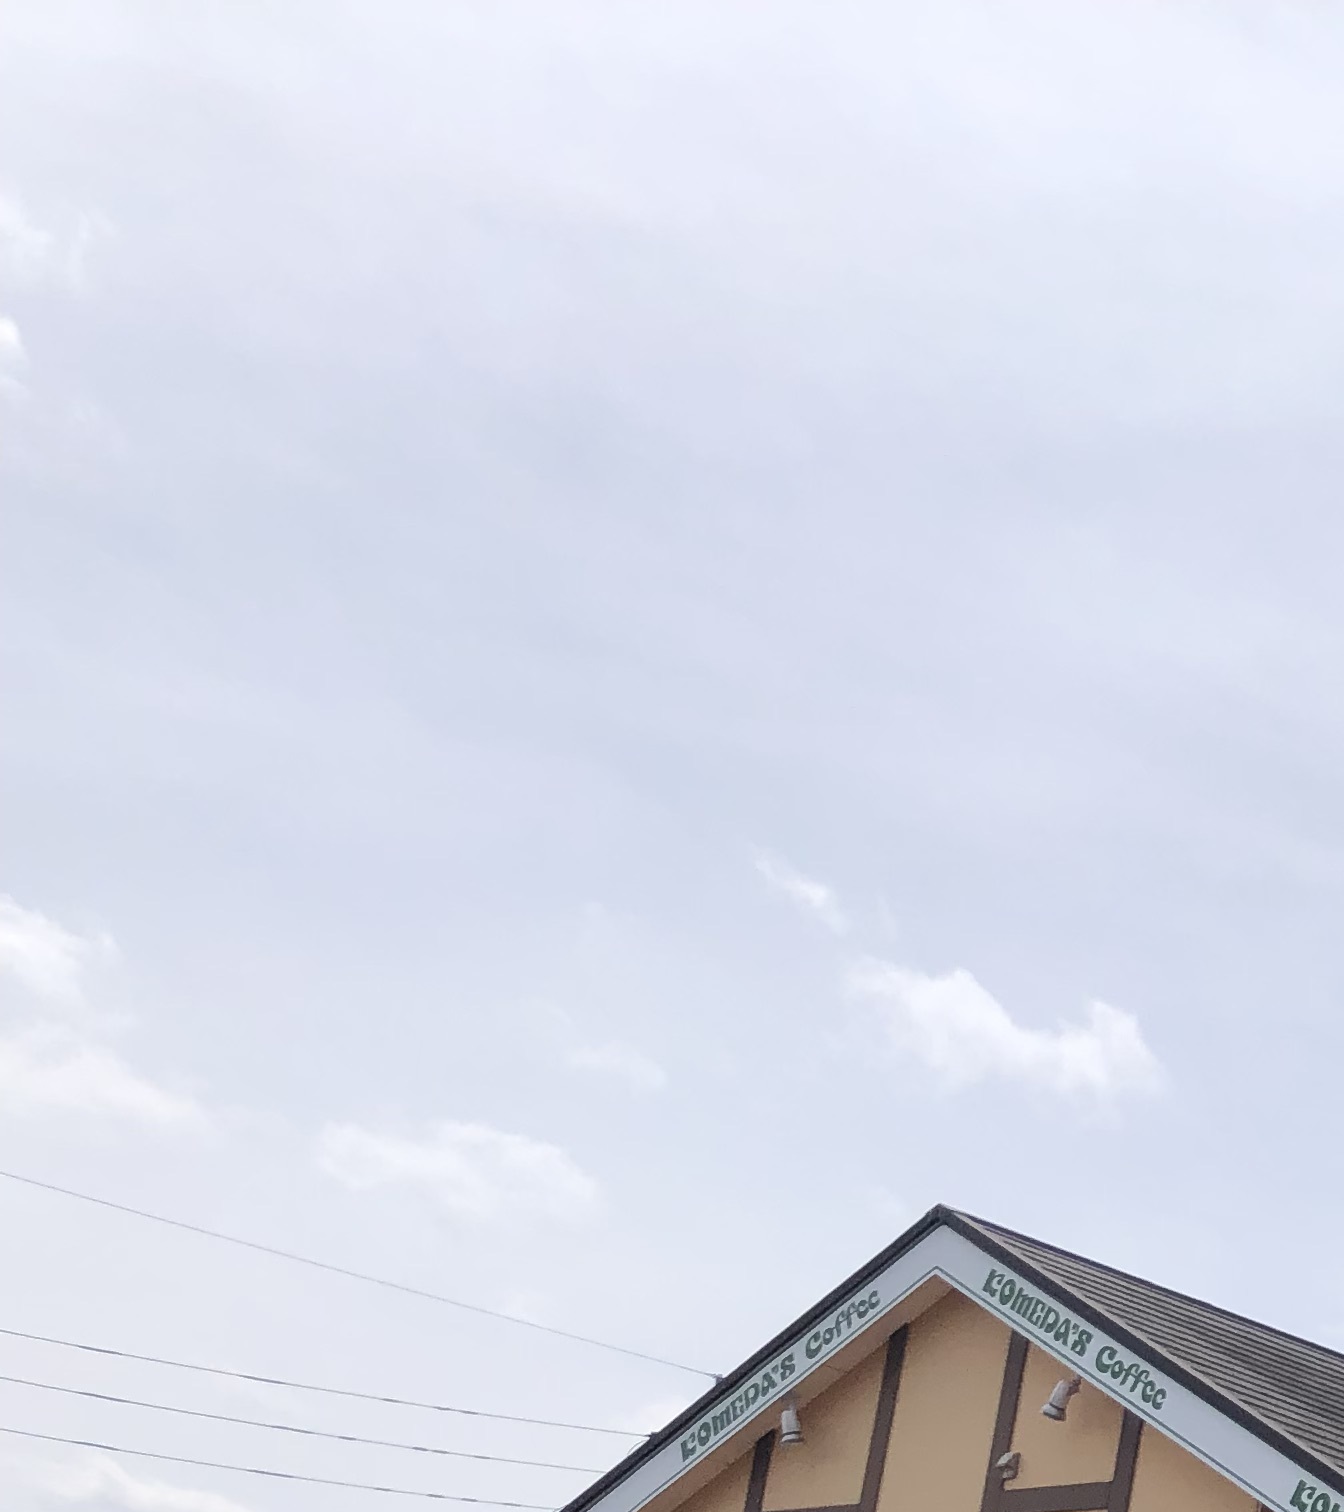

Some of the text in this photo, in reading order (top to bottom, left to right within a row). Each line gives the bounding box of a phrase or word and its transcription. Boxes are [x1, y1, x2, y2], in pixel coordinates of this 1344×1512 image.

[680, 1288, 881, 1463] KOMEDA'S Coffee
[983, 1269, 1167, 1411] KOMEDA'S Coffee
